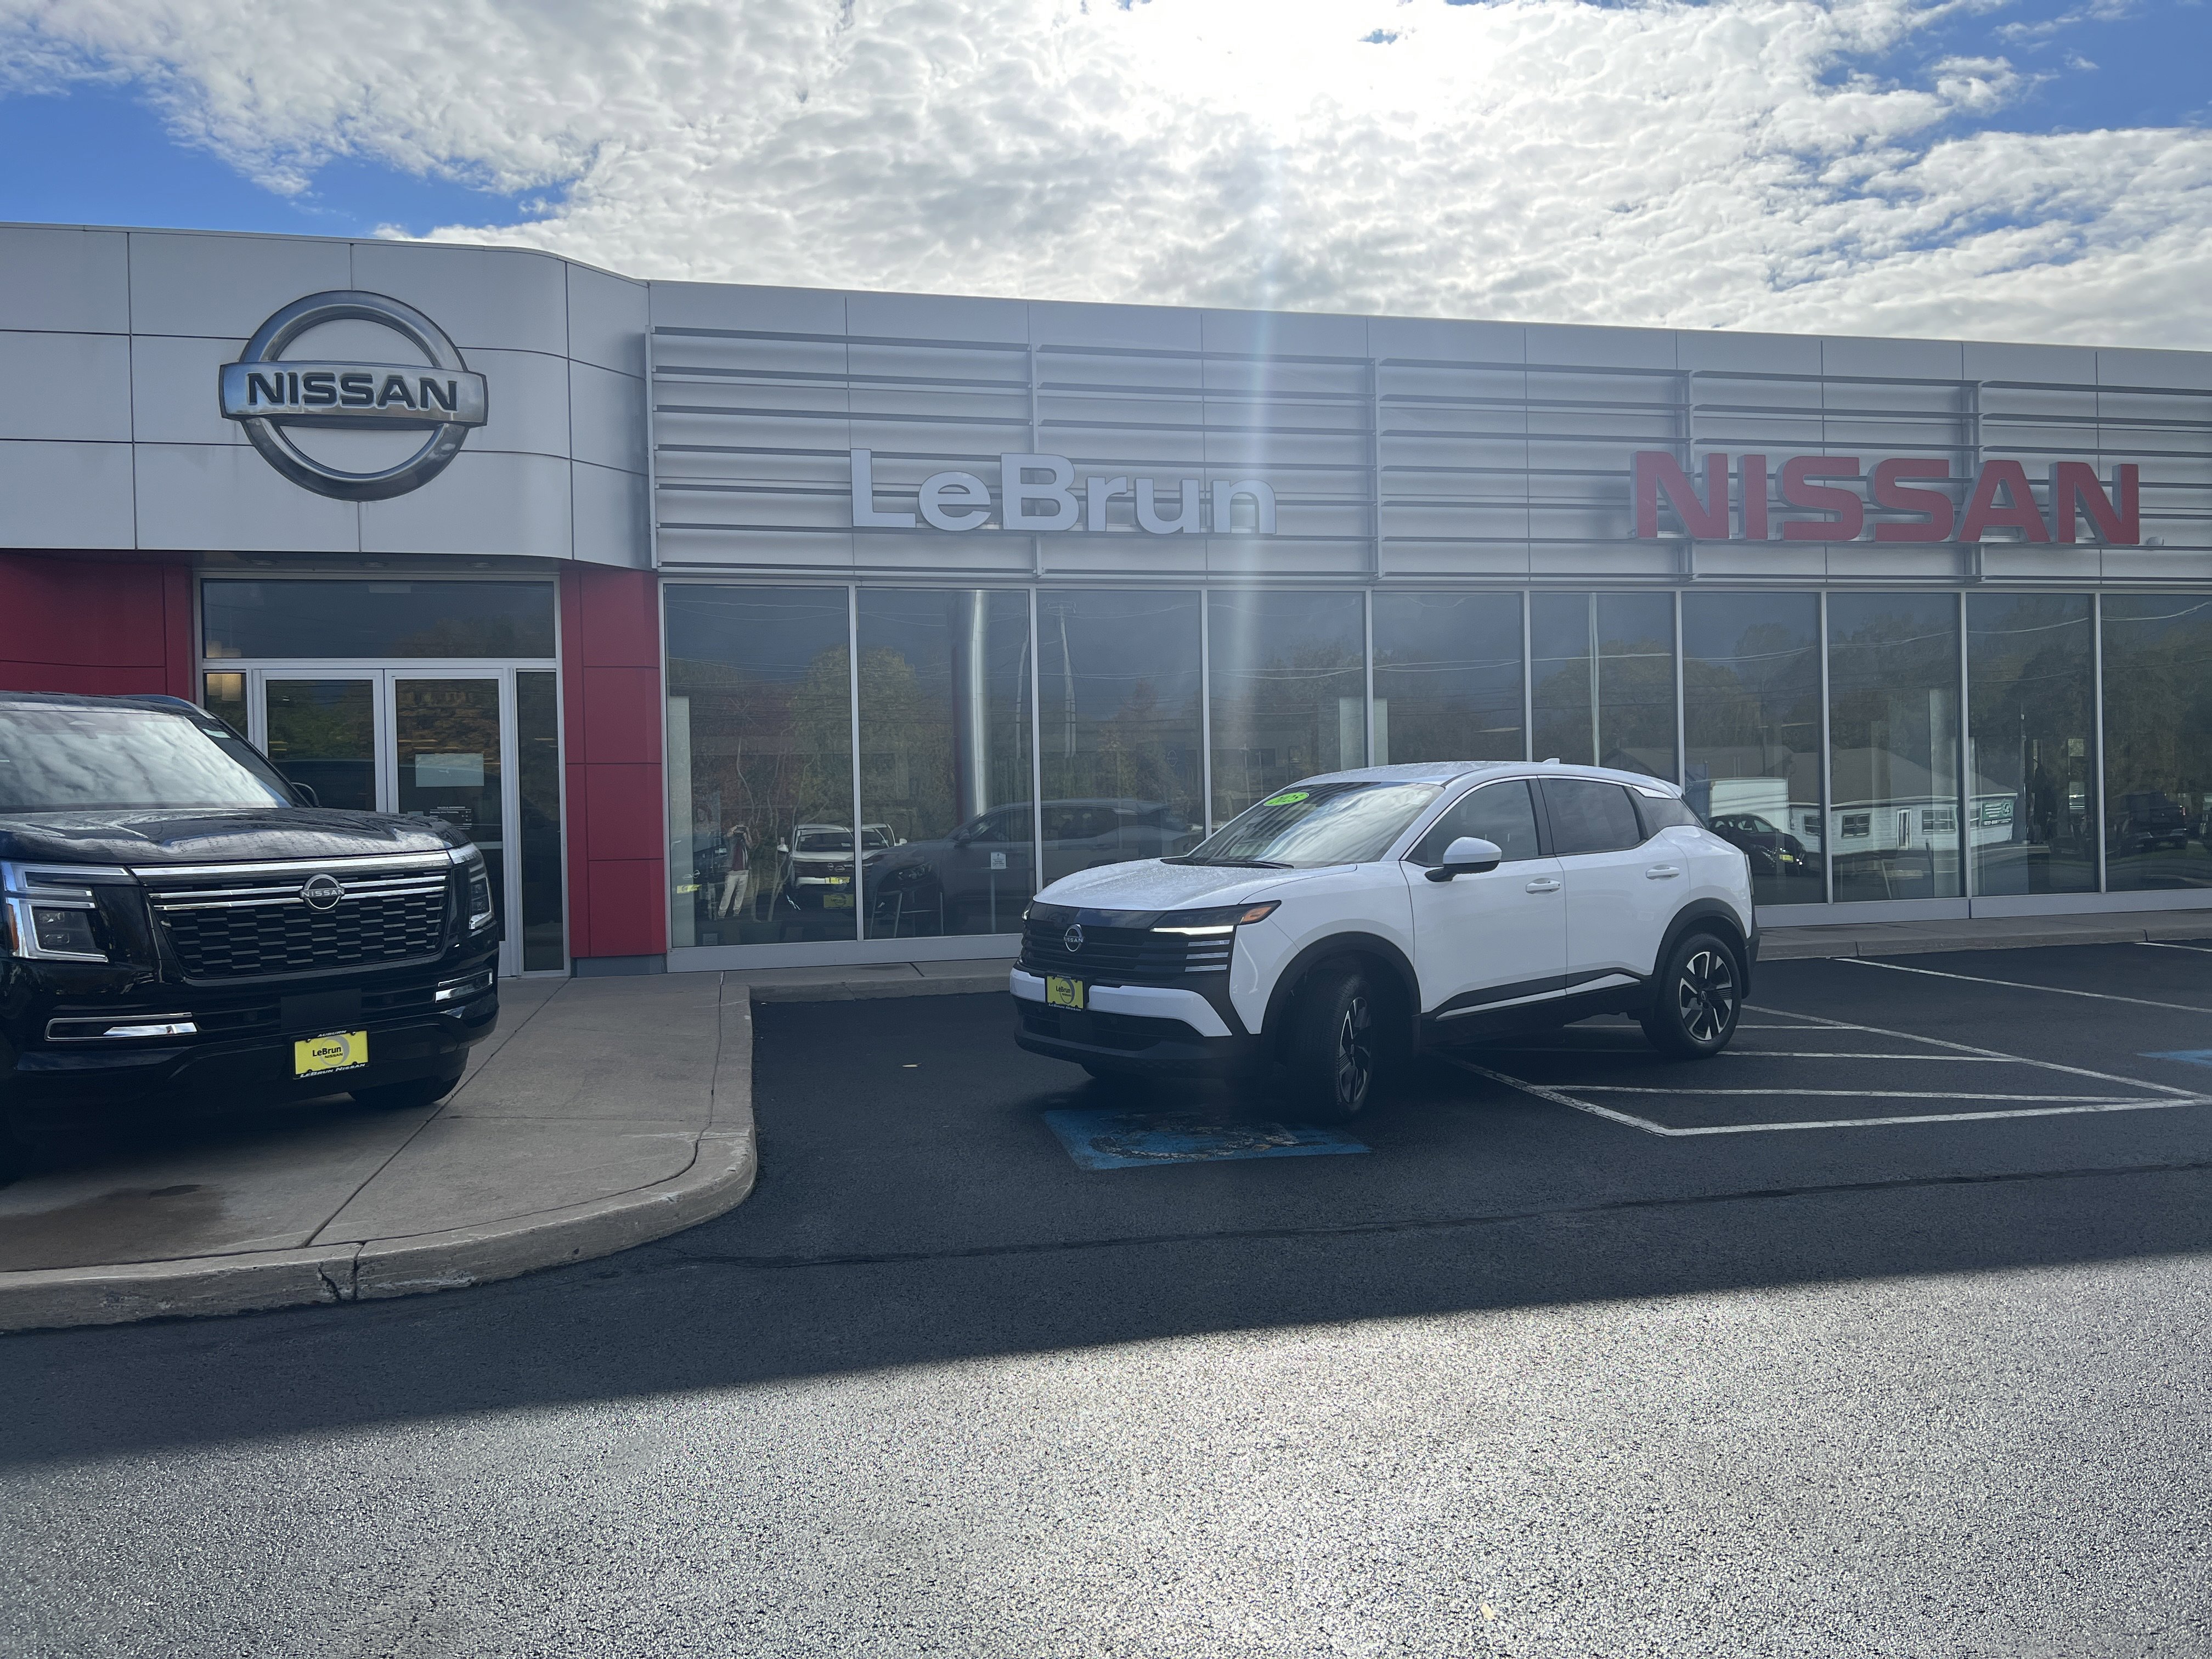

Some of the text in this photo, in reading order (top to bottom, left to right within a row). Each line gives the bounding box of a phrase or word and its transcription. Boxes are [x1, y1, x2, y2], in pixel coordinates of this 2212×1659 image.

[247, 372, 458, 412] NISSAN
[850, 448, 1277, 535] LeBrun
[1630, 450, 2140, 545] NISSAN
[301, 889, 345, 898] NISSAN
[1056, 985, 1071, 994] LeBrun
[312, 1046, 342, 1057] LeBrun
